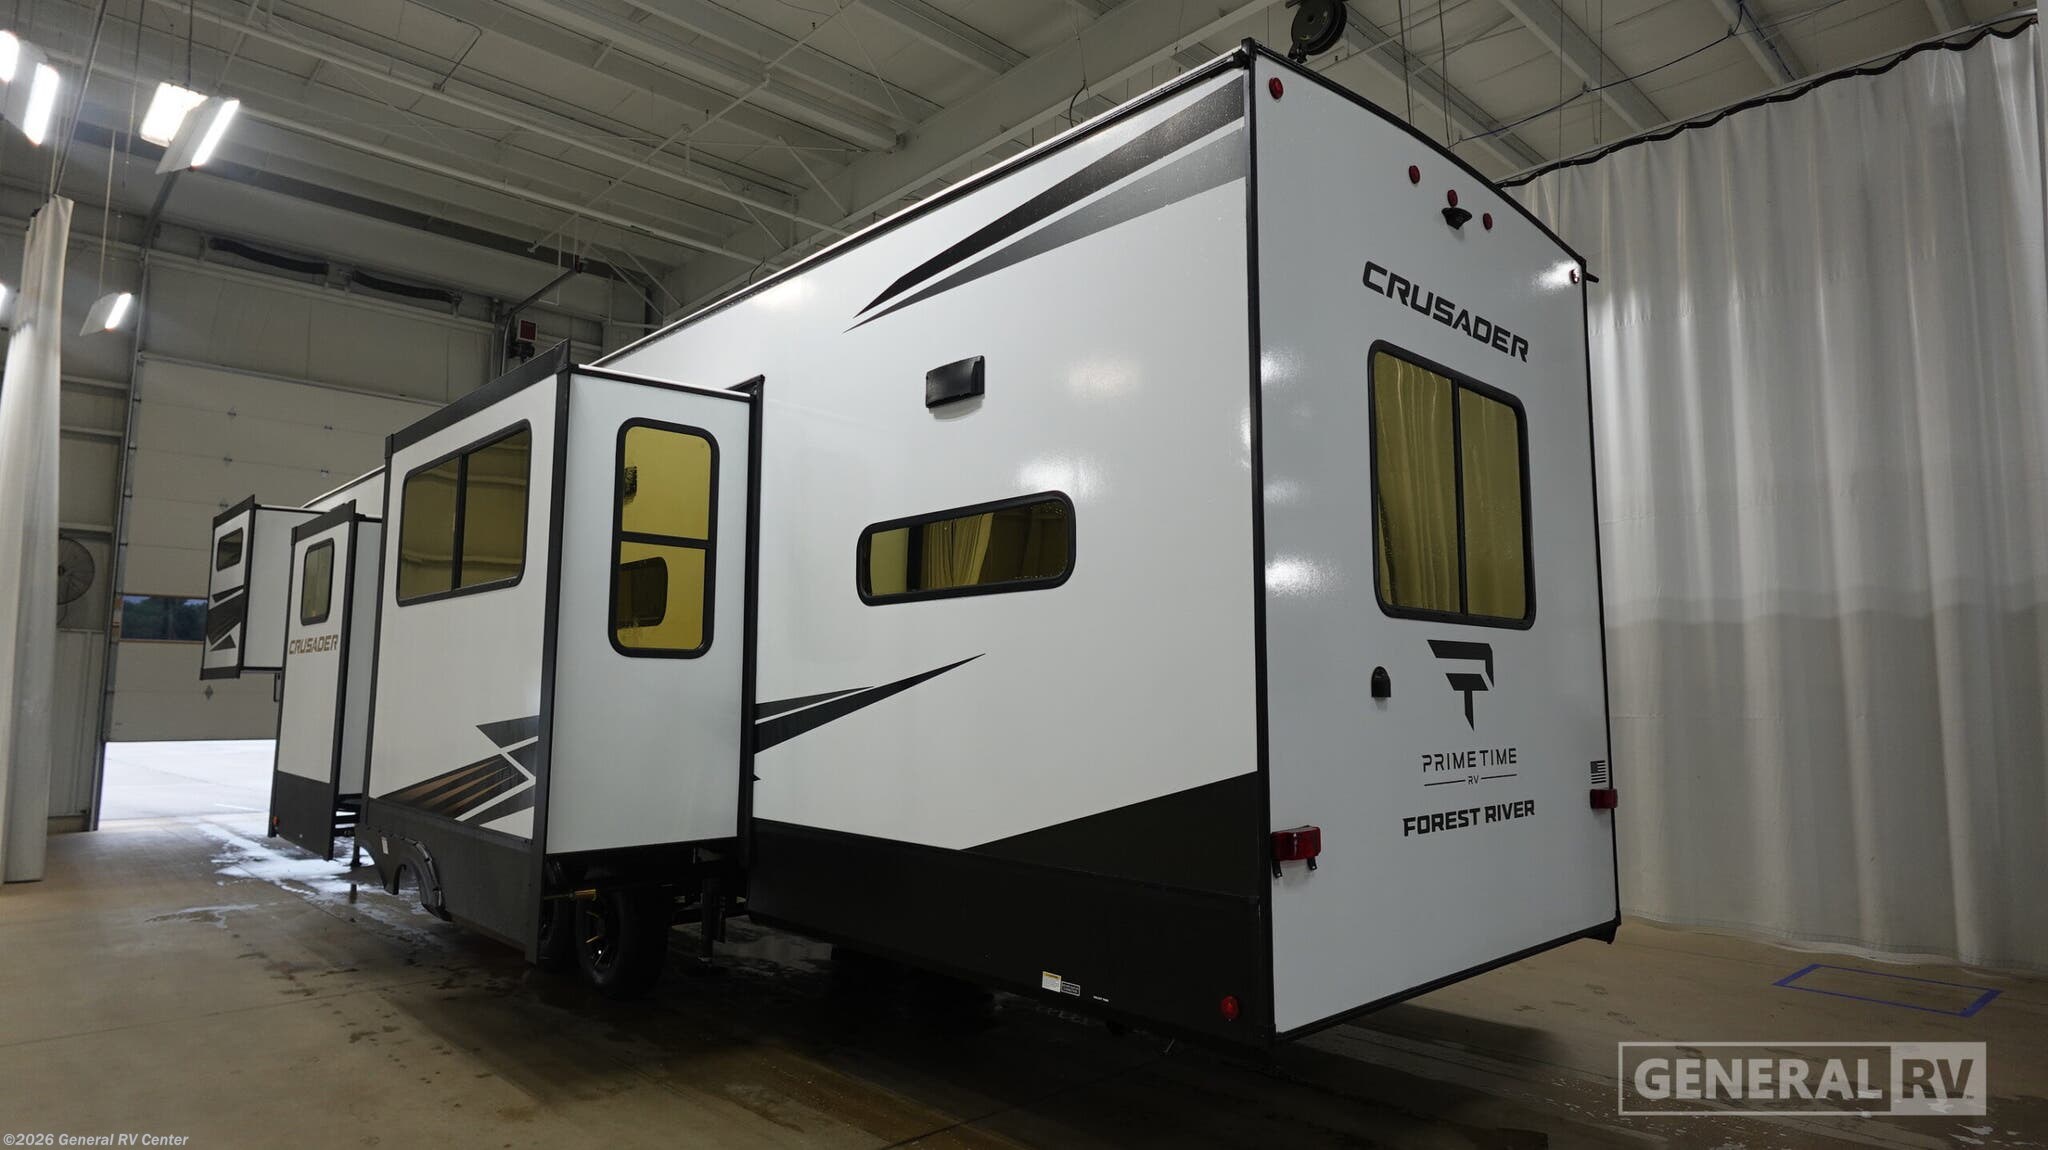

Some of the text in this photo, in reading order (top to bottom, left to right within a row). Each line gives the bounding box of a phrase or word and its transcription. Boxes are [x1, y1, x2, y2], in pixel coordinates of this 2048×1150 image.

[1362, 260, 1529, 363] CRUSADER
[289, 634, 338, 654] CRUSADER
[1467, 776, 1480, 785] RV
[1402, 800, 1536, 837] FOREST RIVER
